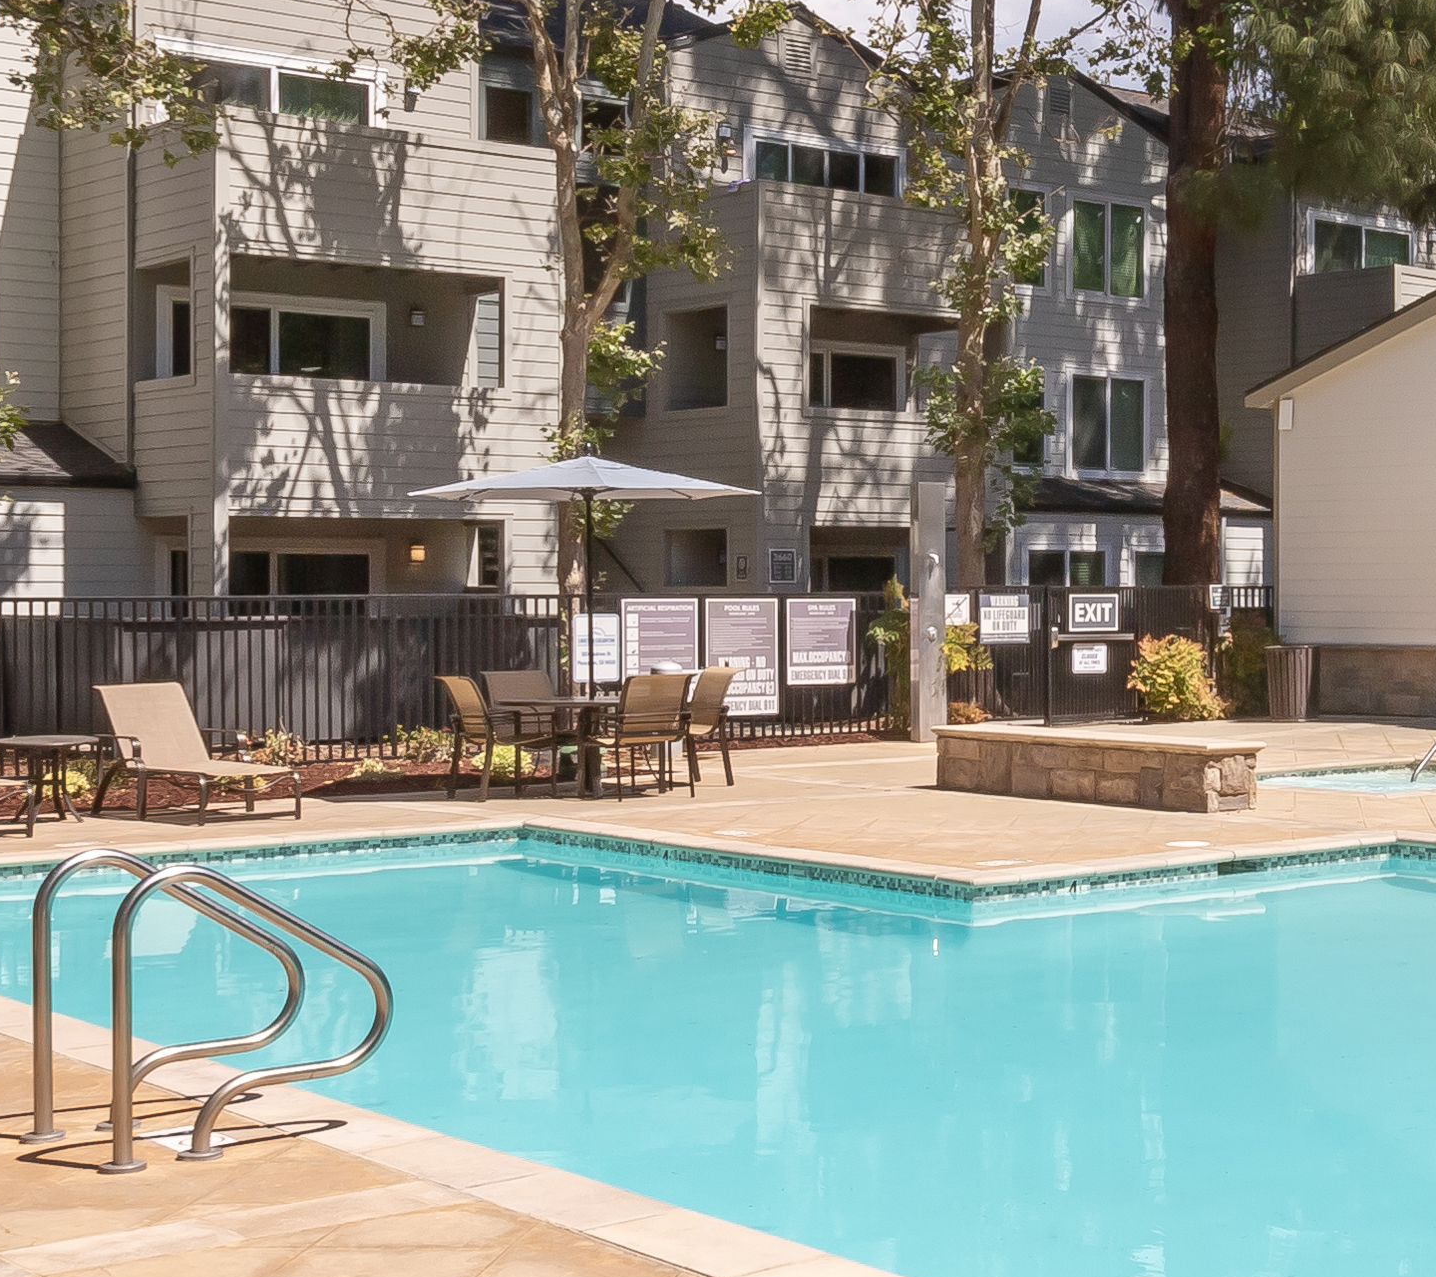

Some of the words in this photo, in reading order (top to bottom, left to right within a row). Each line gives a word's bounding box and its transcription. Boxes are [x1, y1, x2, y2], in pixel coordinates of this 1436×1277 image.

[723, 604, 741, 612] POOL
[741, 604, 760, 612] RULES
[1074, 602, 1113, 623] EXIT
[983, 609, 992, 620] NO
[993, 609, 1026, 620] LIFEGUARD
[992, 621, 1000, 631] ON
[1002, 621, 1017, 631] DUTY
[757, 668, 775, 681] DUTY
[791, 669, 826, 681] EMERGENCY
[748, 699, 762, 711] DIAL
[763, 699, 775, 711] 911
